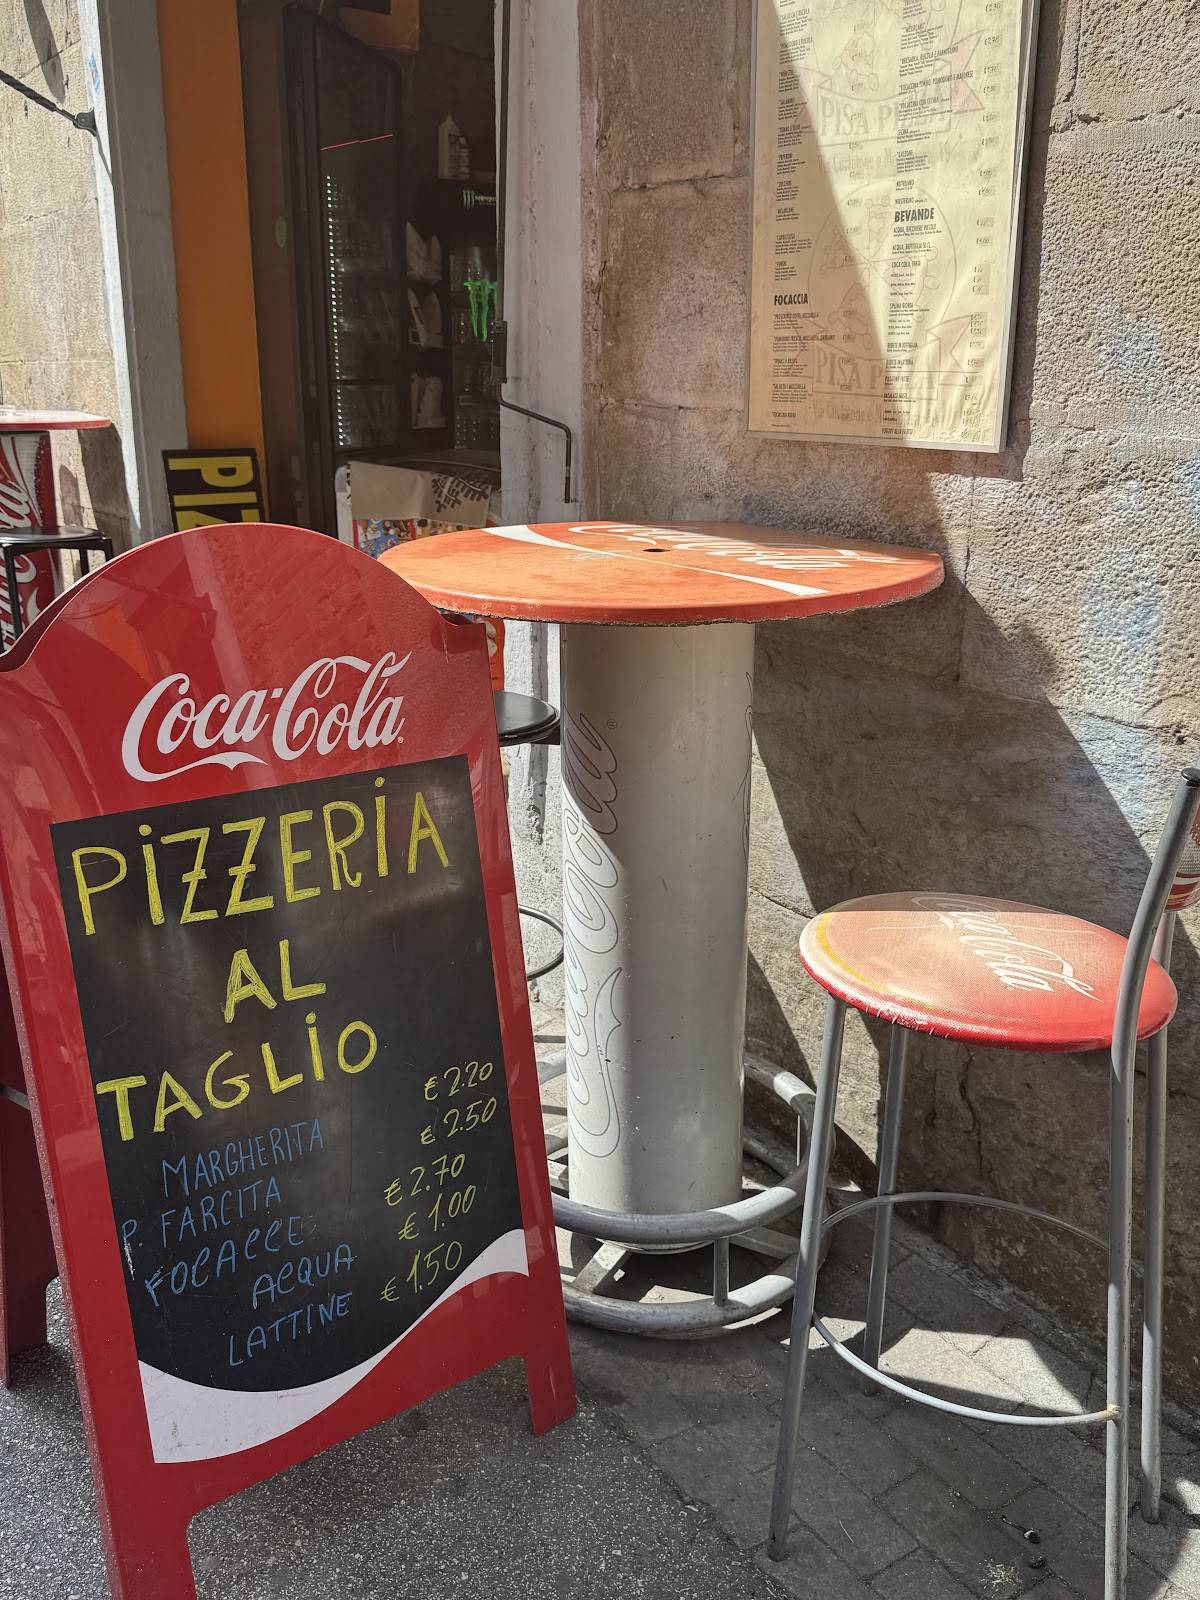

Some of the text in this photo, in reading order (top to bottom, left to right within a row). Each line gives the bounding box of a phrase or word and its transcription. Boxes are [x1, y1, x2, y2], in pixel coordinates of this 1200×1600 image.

[894, 207, 935, 222] BEVANDE
[774, 293, 808, 306] FOCACCIA
[121, 651, 413, 782] Coca-Cola
[71, 776, 450, 936] PIZZERIA
[223, 939, 327, 1024] AL
[96, 1012, 378, 1141] TAGLIO
[424, 1061, 493, 1101] € 2.20
[420, 1096, 497, 1145] € 2.50
[162, 1119, 325, 1199] MARGHERITA
[384, 1153, 466, 1207] € 2.70
[161, 1175, 282, 1248] FARCITA
[398, 1185, 477, 1241] € 1.00
[144, 1215, 305, 1307] FOCACCE
[252, 1243, 357, 1309] ACQUA
[380, 1240, 463, 1302] € 1.50
[228, 1292, 353, 1368] LATTINE
